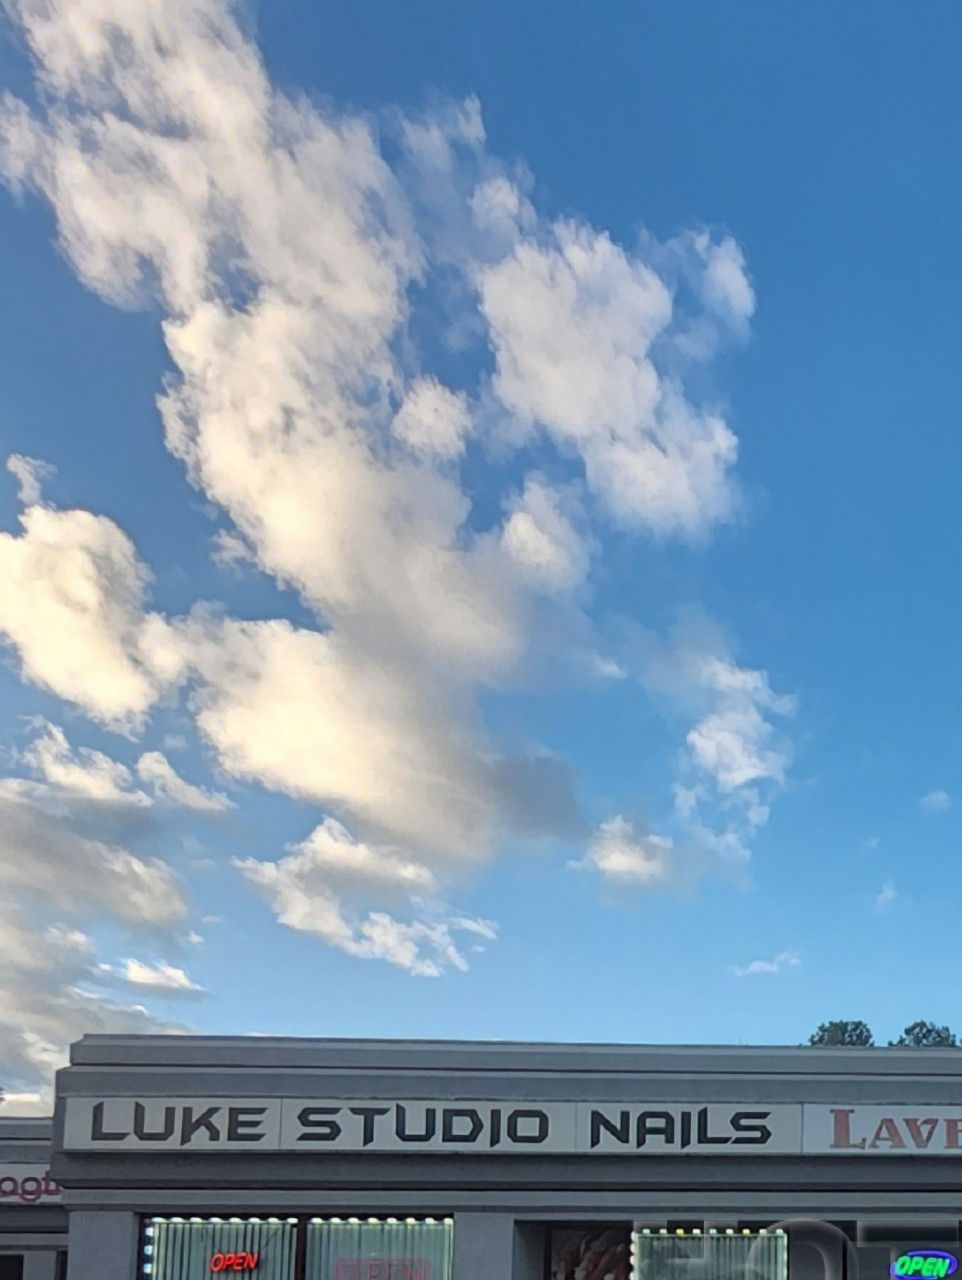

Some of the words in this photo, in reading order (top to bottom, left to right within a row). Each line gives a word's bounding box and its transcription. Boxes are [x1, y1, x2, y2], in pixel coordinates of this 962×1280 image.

[91, 1100, 269, 1146] LUKE
[296, 1103, 549, 1148] STUDIO
[590, 1105, 773, 1150] NAILS
[211, 1251, 258, 1272] OPEN
[896, 1256, 950, 1278] OPEN
